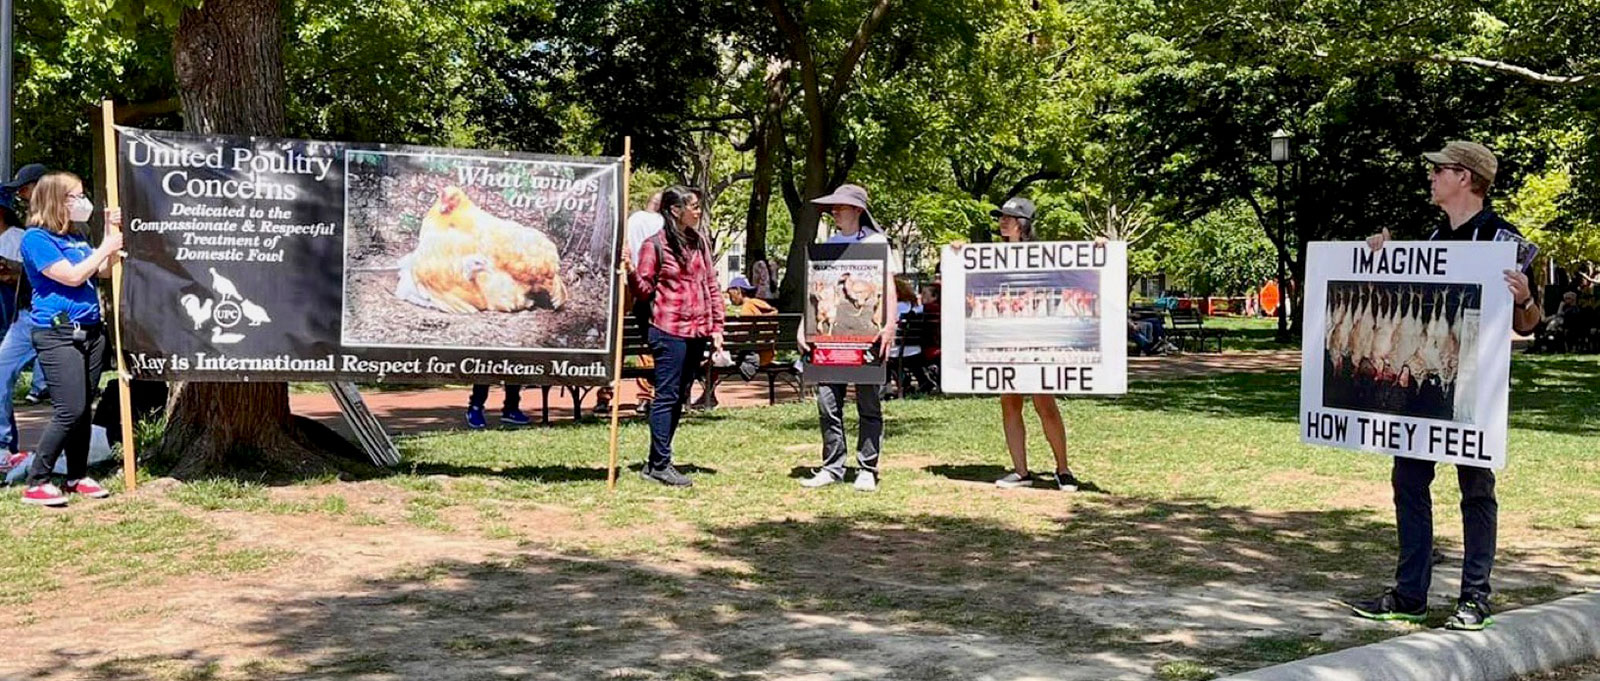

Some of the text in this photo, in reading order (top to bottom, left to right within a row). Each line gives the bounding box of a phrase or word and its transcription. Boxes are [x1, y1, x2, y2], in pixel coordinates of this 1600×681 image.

[126, 140, 333, 181] United Poultry
[162, 171, 298, 200] Concerns
[455, 165, 599, 196] What wings
[170, 203, 292, 220] Dedicated to the
[509, 192, 598, 214] are for!
[130, 218, 335, 237] Compassionate & Respectful
[182, 232, 282, 250] Treatment of
[175, 248, 284, 262] Domestic Fowl
[964, 244, 1107, 270] SENTENCED
[1352, 247, 1448, 275] IMAGINE
[217, 309, 239, 320] UPC
[130, 353, 607, 377] May is International Respect for Chickens Month
[971, 366, 1093, 391] FOR LIFE
[1307, 411, 1492, 461] HOW THEY FEEL
